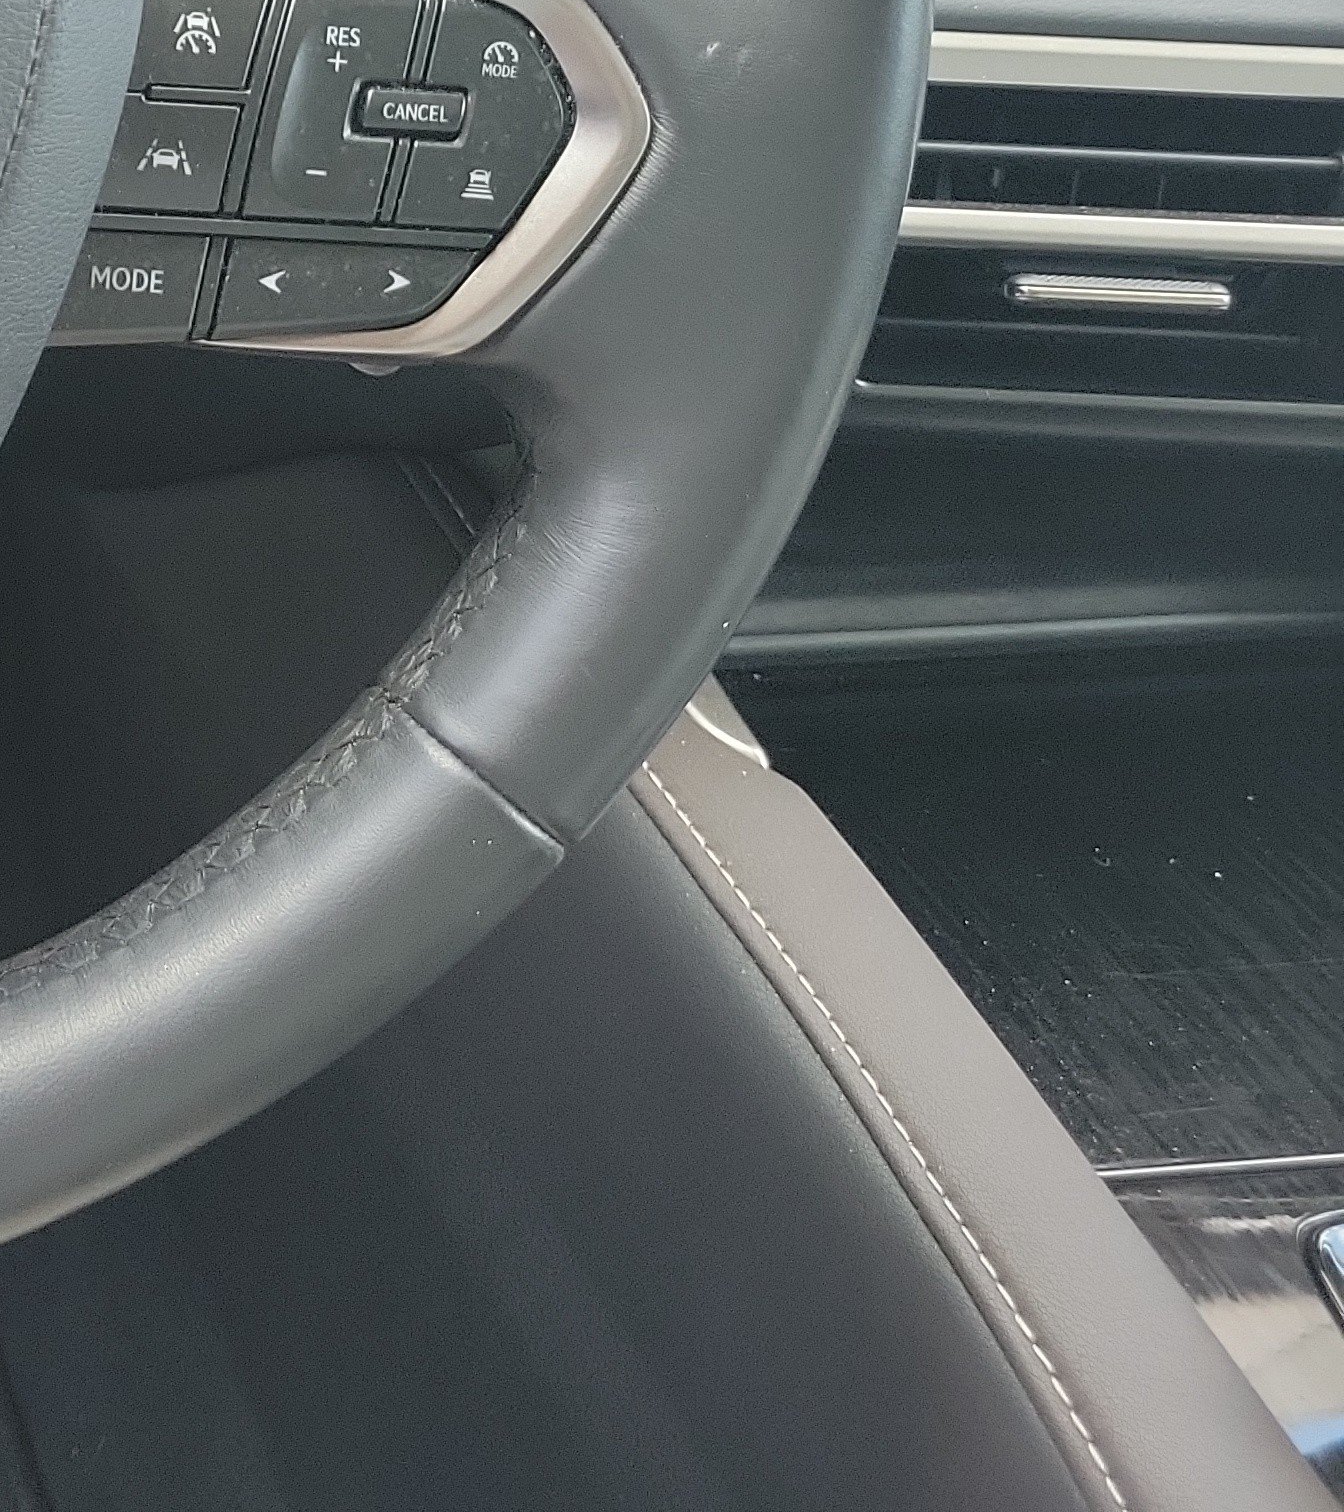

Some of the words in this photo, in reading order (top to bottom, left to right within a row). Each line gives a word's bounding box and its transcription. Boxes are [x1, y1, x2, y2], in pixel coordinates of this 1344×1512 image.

[325, 25, 361, 48] RES
[481, 62, 518, 79] MODE
[383, 102, 449, 124] CANCEL
[90, 266, 165, 294] MODE
